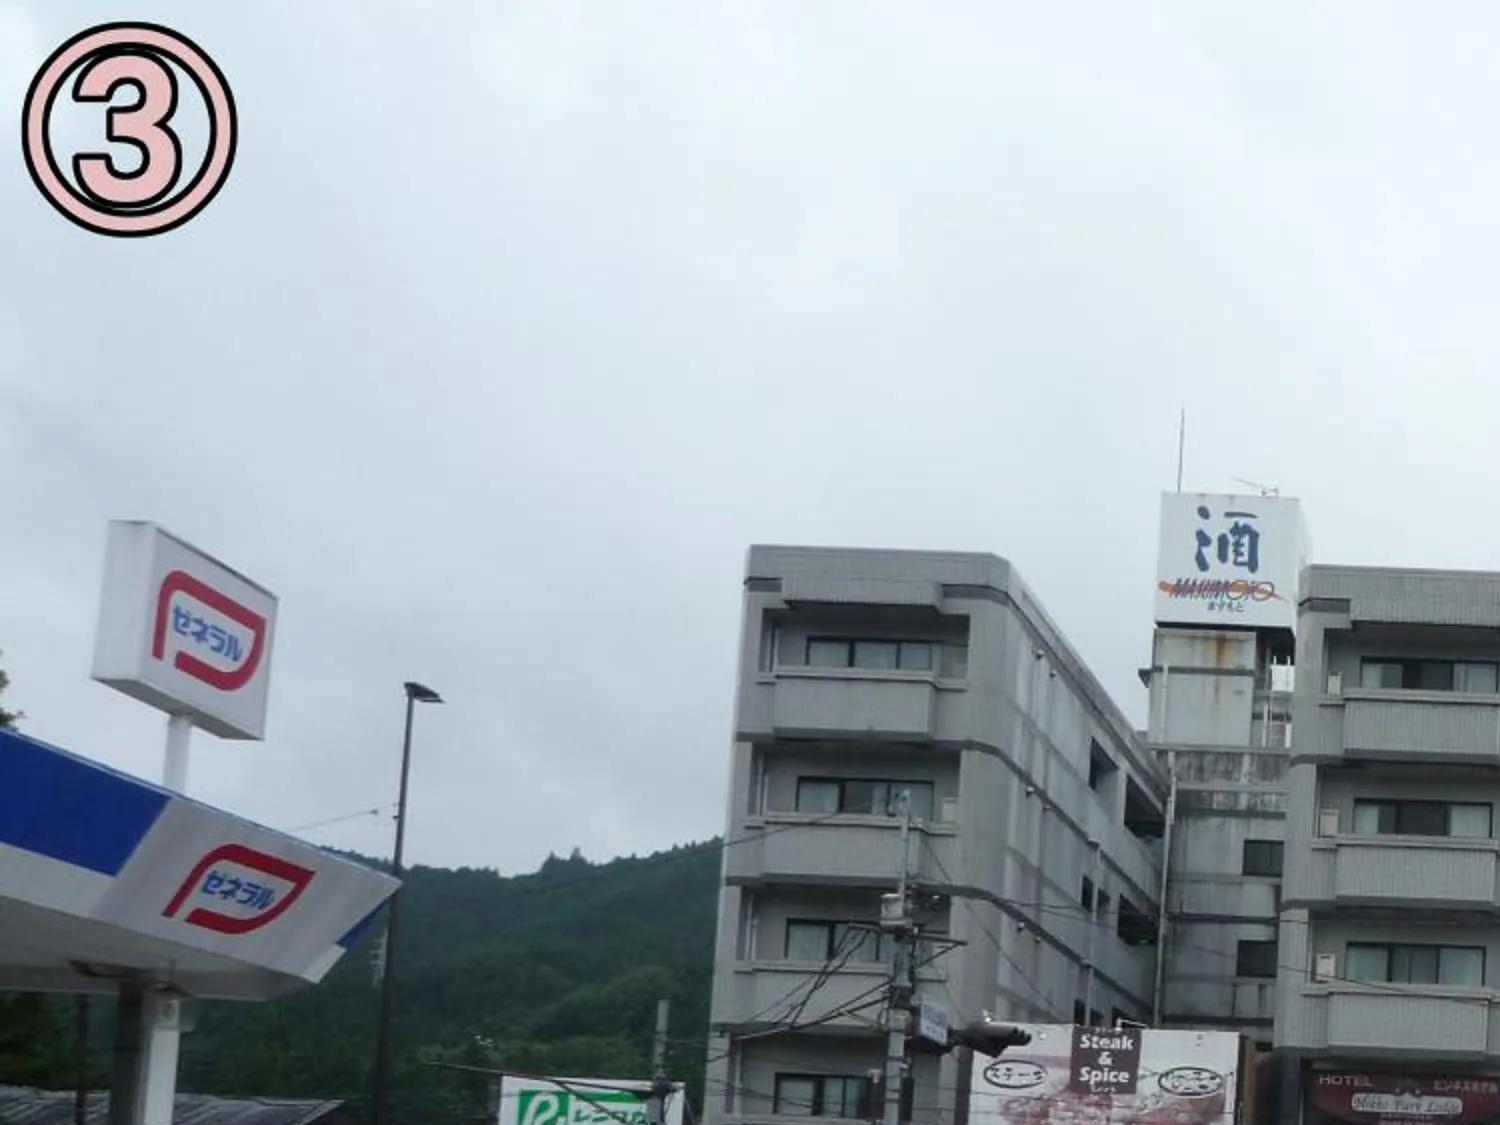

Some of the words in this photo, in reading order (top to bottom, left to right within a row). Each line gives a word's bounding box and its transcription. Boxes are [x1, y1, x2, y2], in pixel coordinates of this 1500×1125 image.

[1195, 506, 1260, 574] 酒
[172, 606, 243, 663] ゼネラル
[201, 870, 276, 911] ゼネラル
[1080, 1033, 1134, 1051] Steak
[1097, 1051, 1114, 1066] &
[1079, 1067, 1130, 1085] Spice
[1319, 1074, 1374, 1087] HOTEL
[573, 1108, 650, 1125] レンタカ
